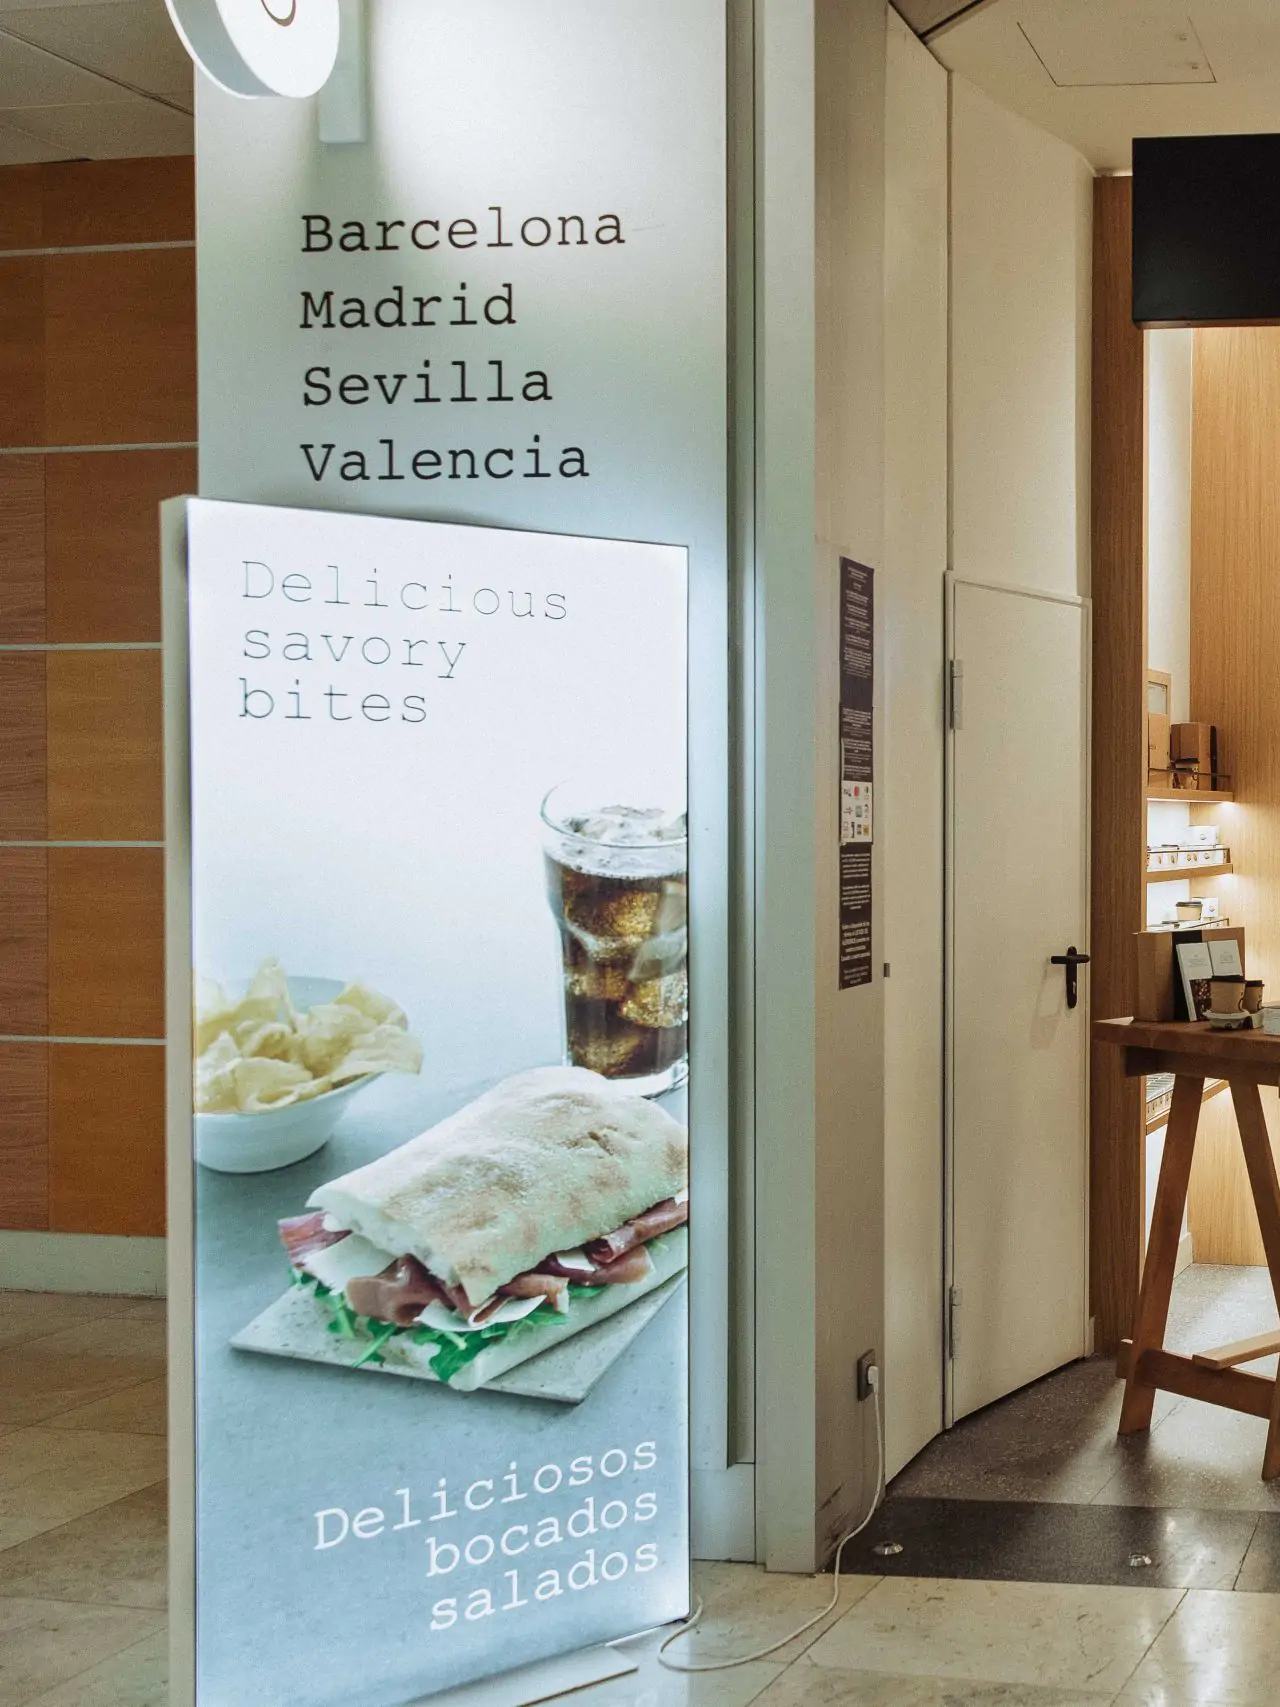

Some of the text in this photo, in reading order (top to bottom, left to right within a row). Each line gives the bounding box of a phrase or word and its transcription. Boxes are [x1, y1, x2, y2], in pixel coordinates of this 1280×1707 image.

[301, 206, 626, 253] Barcelona
[299, 282, 516, 329] Madrid
[303, 359, 553, 406] Sevilla
[299, 434, 590, 482] Valencia
[241, 560, 568, 620] Delicious
[243, 629, 467, 679] savory
[238, 677, 428, 723] bites
[313, 1440, 658, 1551] Deliciosos
[424, 1491, 659, 1578] bocados
[429, 1540, 660, 1631] salados
